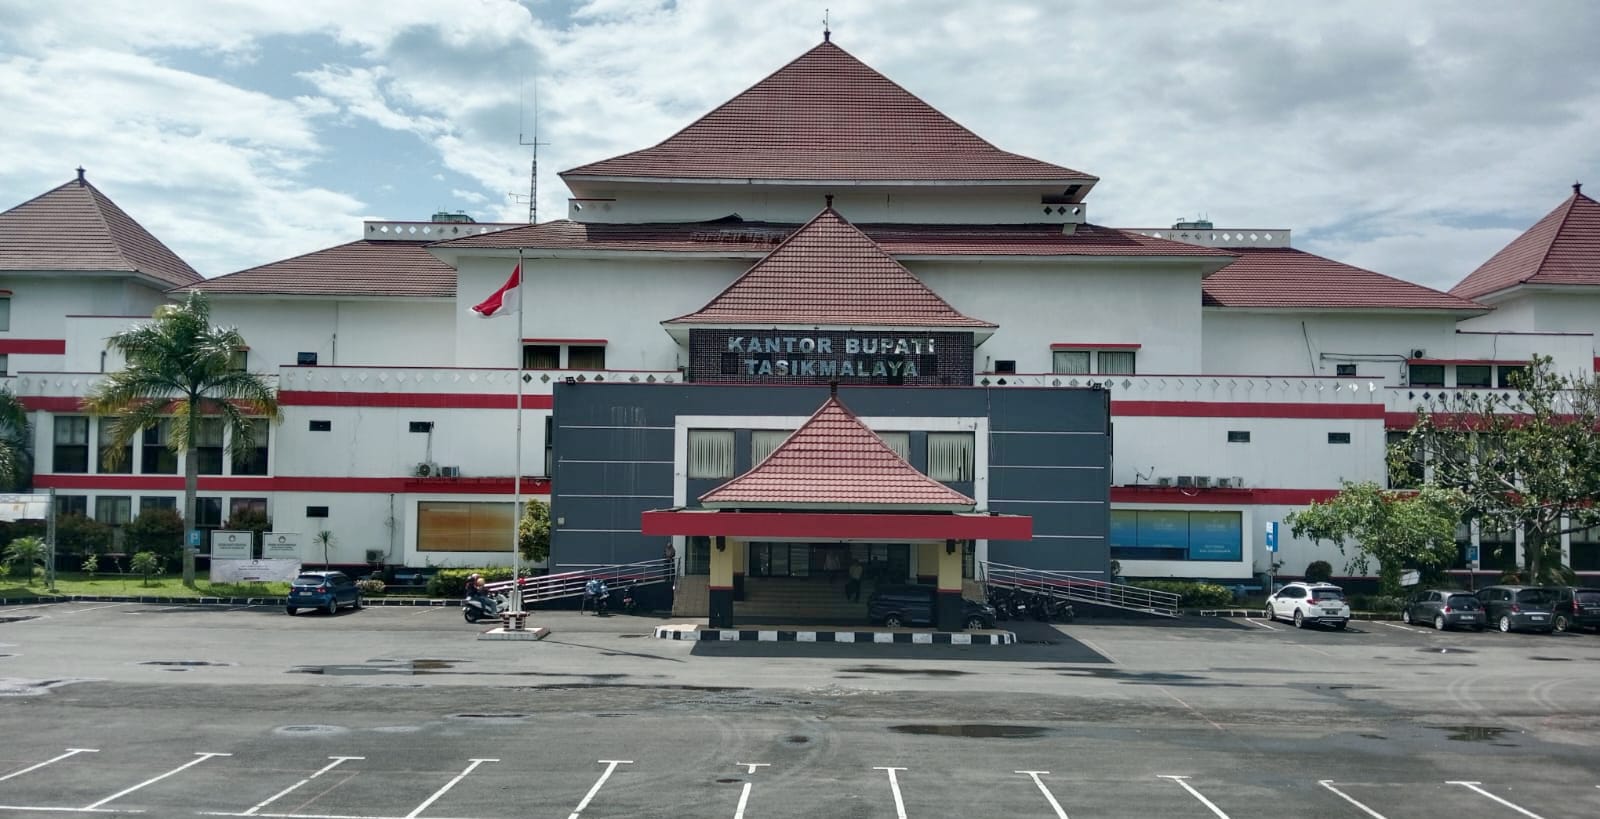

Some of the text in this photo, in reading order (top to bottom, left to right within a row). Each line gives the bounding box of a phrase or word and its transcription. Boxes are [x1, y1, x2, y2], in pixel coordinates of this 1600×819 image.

[728, 336, 935, 354] KANTOR BUPATI
[744, 359, 918, 377] TASIKMALAYA
